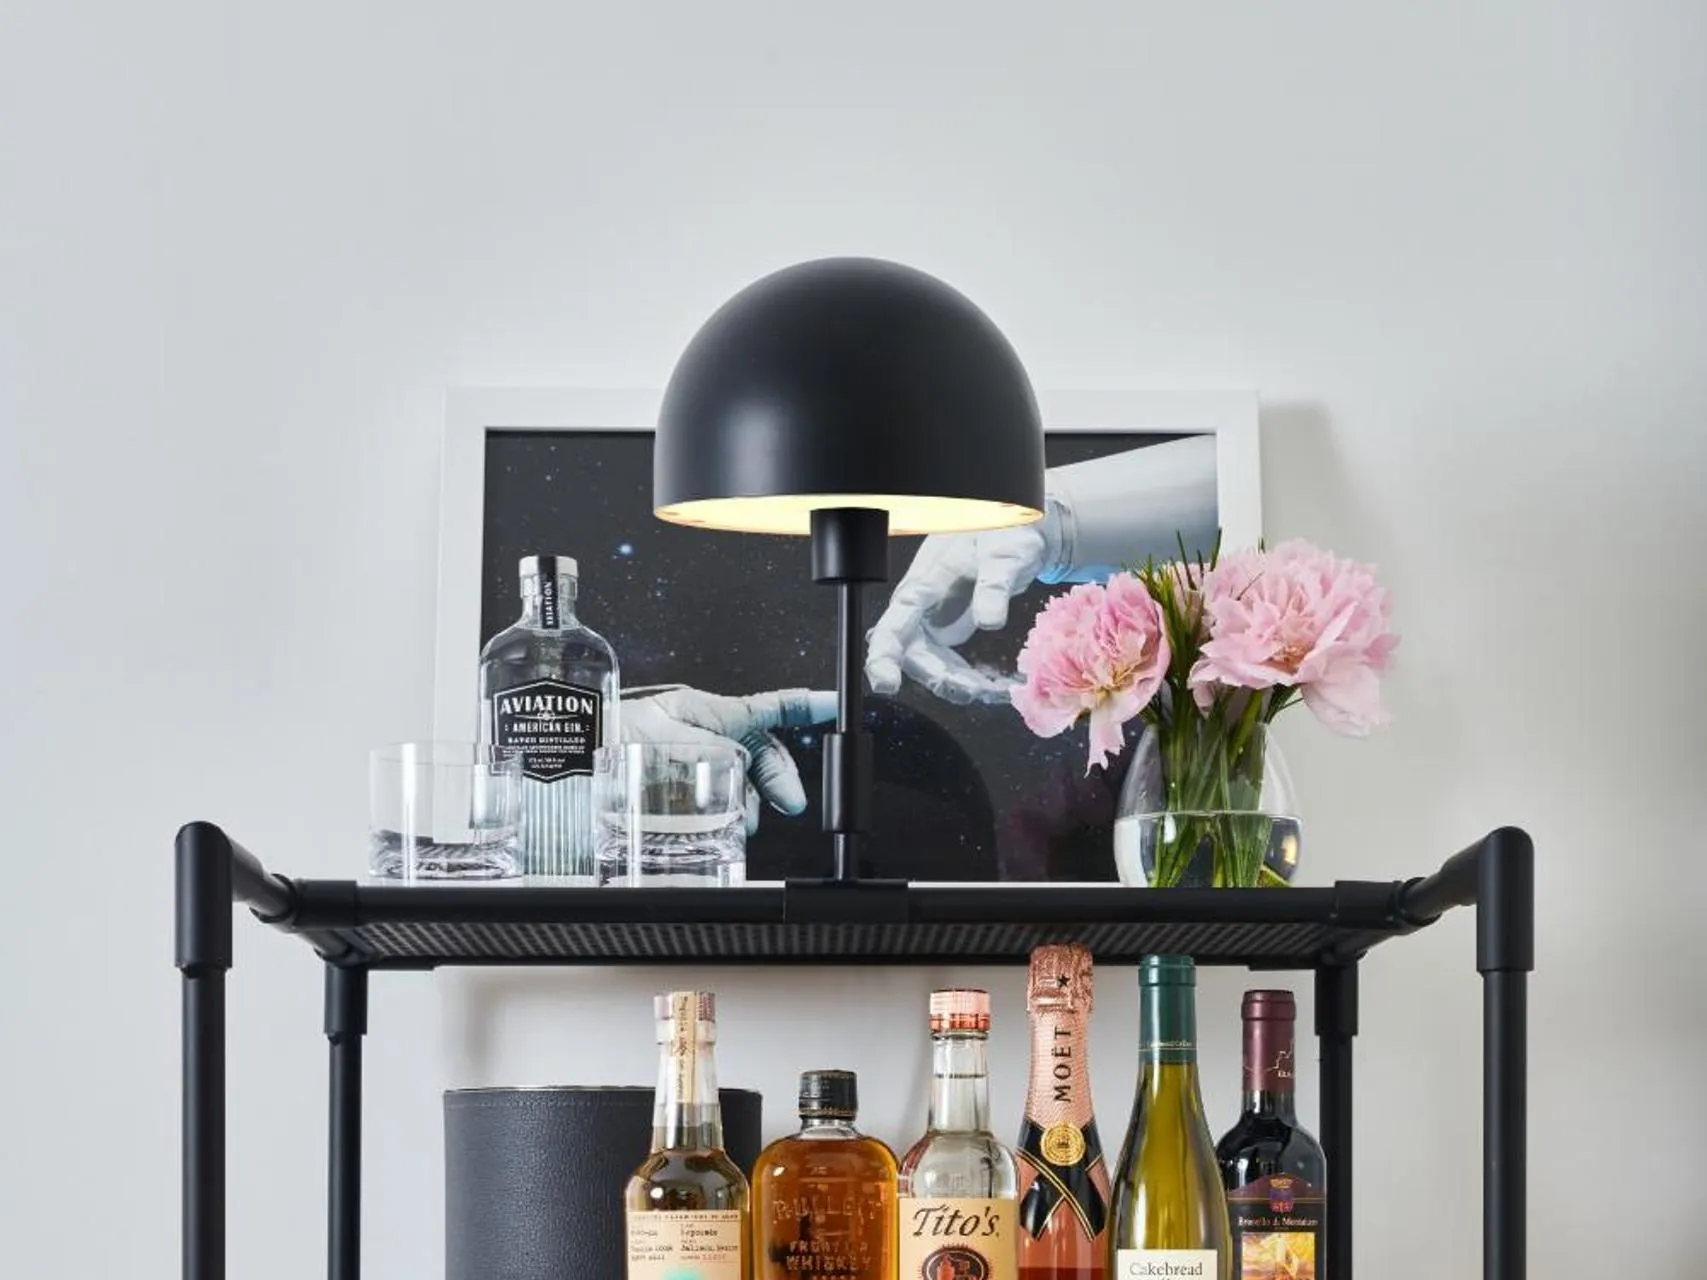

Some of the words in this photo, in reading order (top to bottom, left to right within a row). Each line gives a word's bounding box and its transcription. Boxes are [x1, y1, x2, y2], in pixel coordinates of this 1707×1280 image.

[500, 695, 594, 715] AVIATION
[513, 722, 560, 733] AMERICAN
[1051, 1025, 1072, 1102] MOËT
[912, 1203, 1000, 1237] Tito's
[1129, 1261, 1204, 1277] Cakebread
